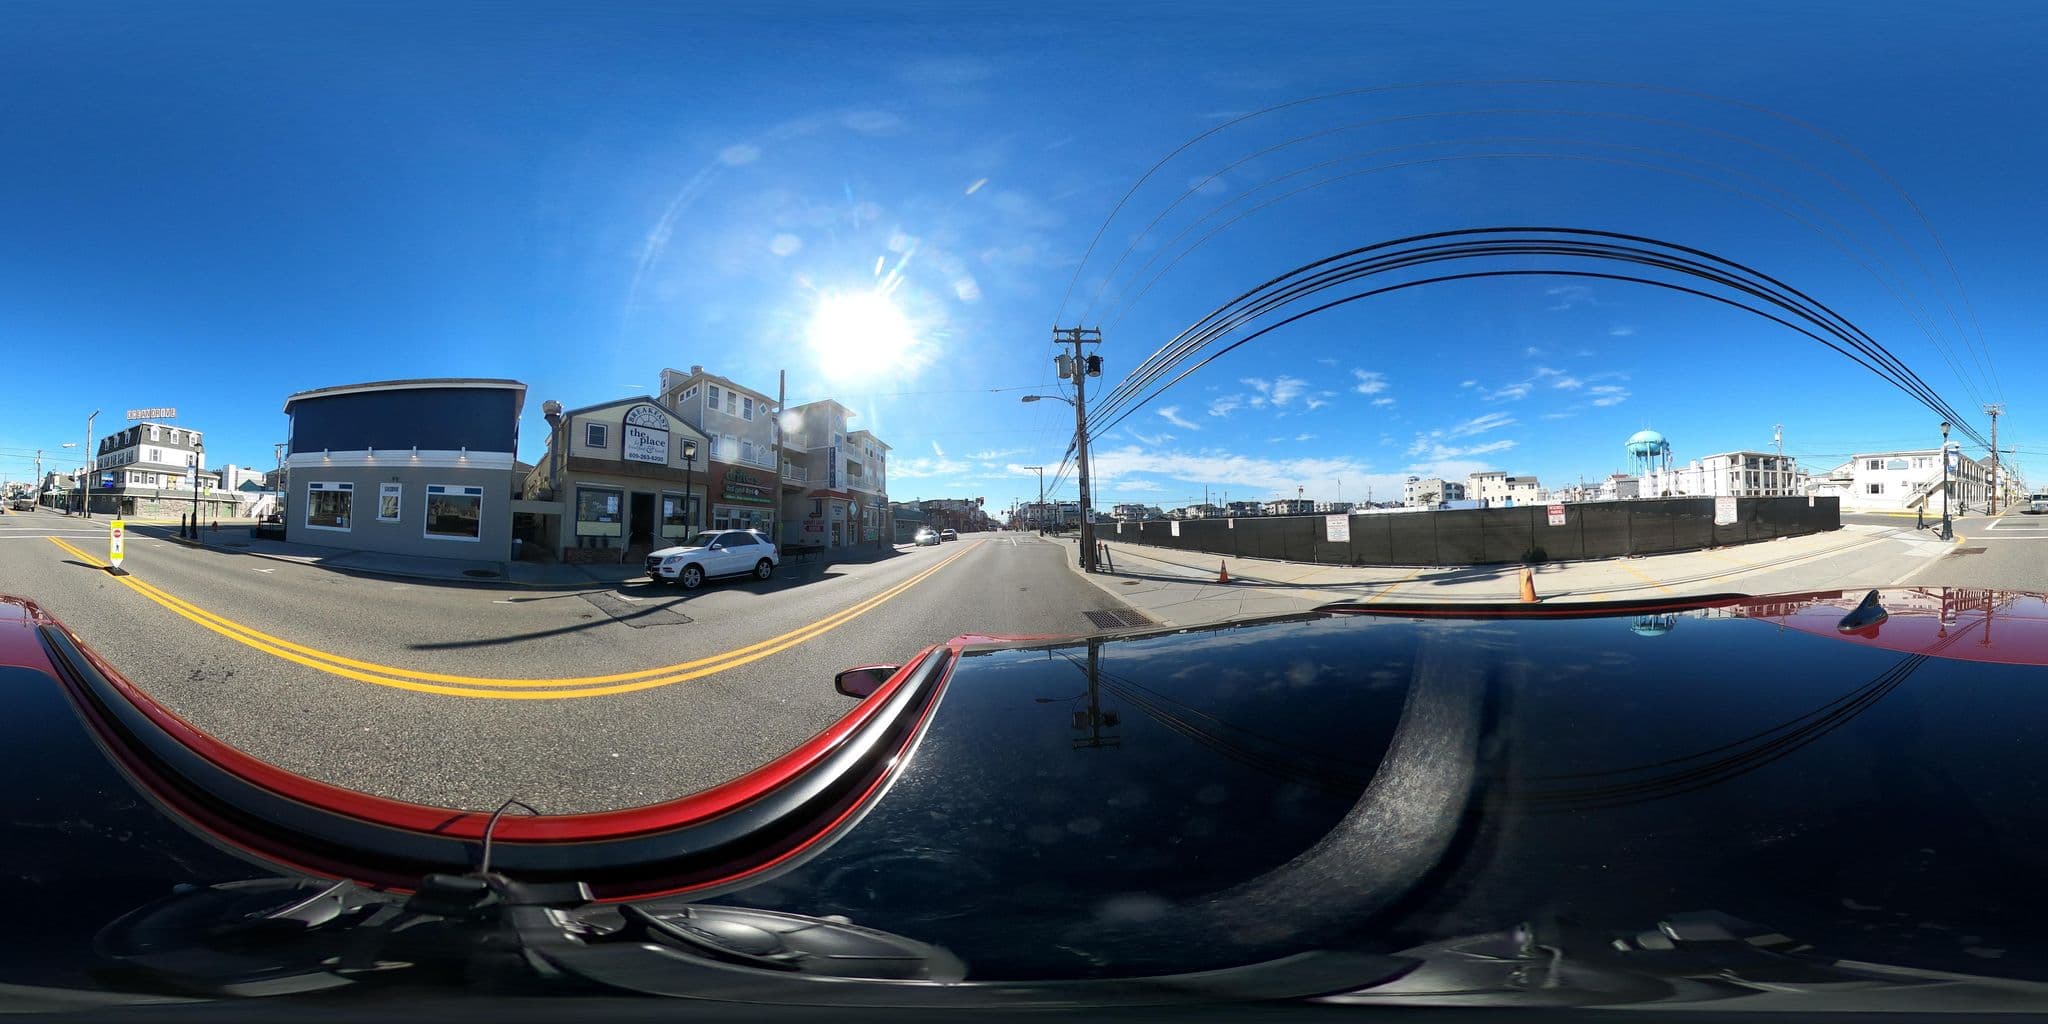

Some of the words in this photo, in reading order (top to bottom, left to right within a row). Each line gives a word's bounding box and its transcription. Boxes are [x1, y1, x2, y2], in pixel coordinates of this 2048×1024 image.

[128, 410, 151, 418] OCEAN
[152, 409, 175, 418] DRIVE
[629, 407, 667, 427] BREAKFAST
[630, 428, 646, 438] the
[640, 436, 665, 447] place
